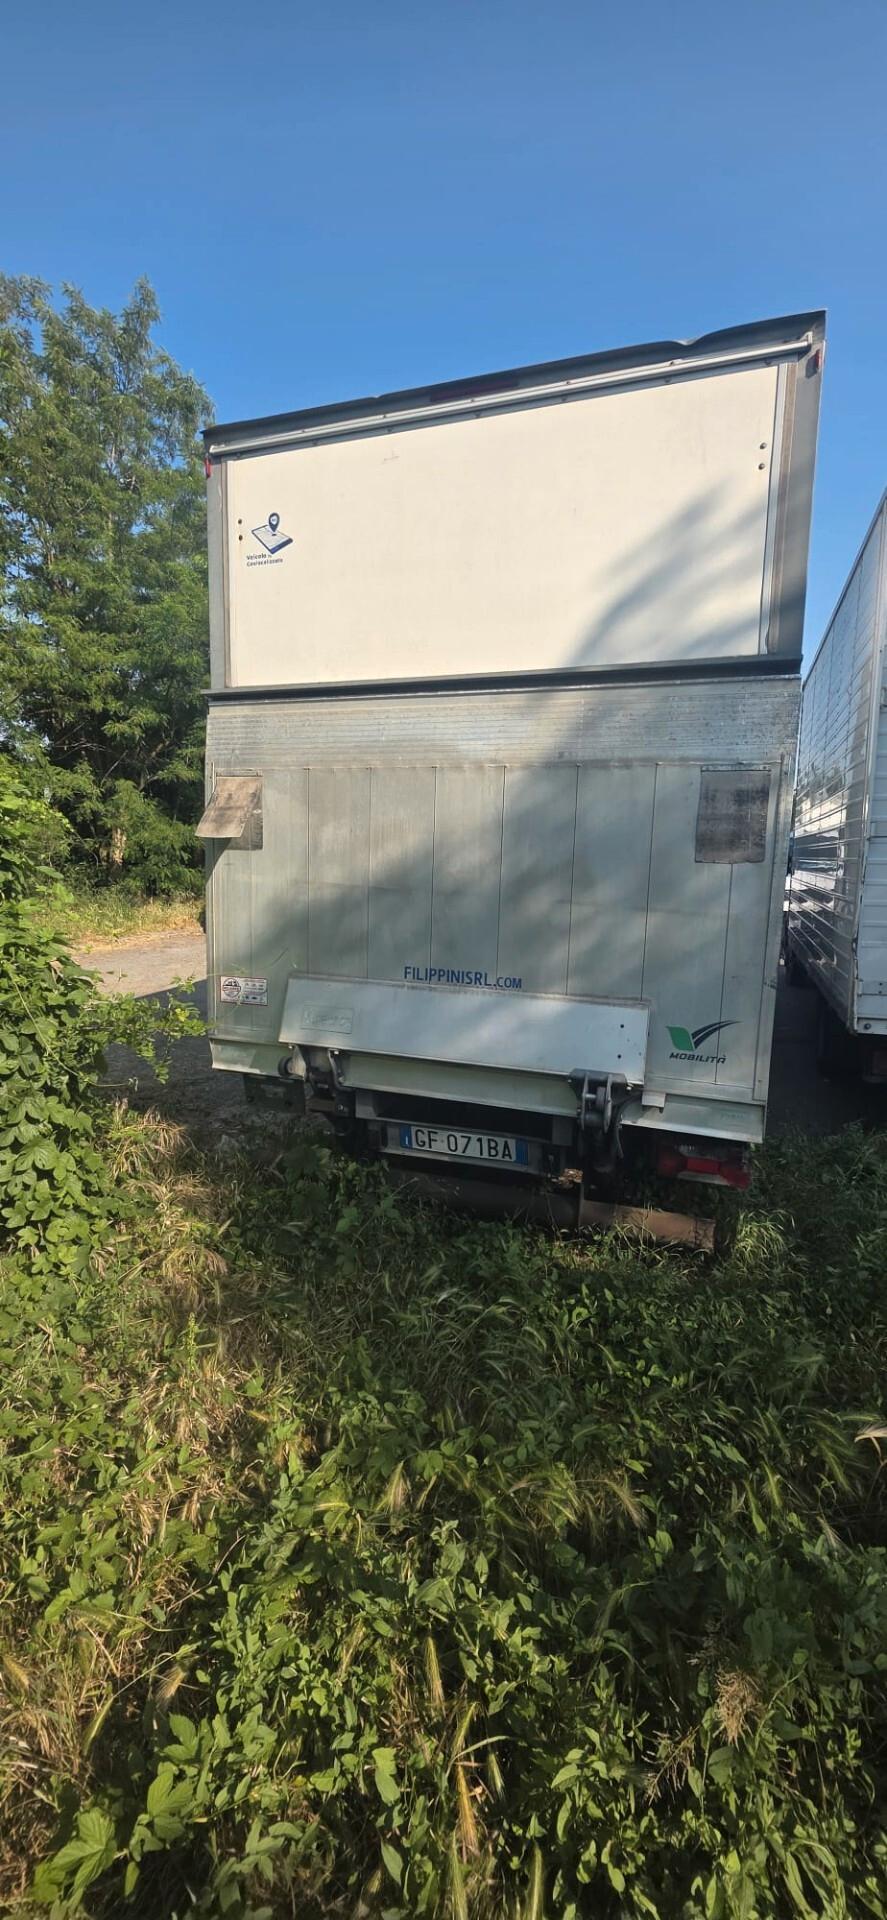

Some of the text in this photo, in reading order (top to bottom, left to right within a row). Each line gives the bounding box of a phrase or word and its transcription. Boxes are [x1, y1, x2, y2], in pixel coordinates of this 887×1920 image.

[404, 966, 522, 989] FILIPPINISRL.COM
[669, 1052, 727, 1064] MOBILITÀ
[415, 1129, 513, 1160] GF 071BA
